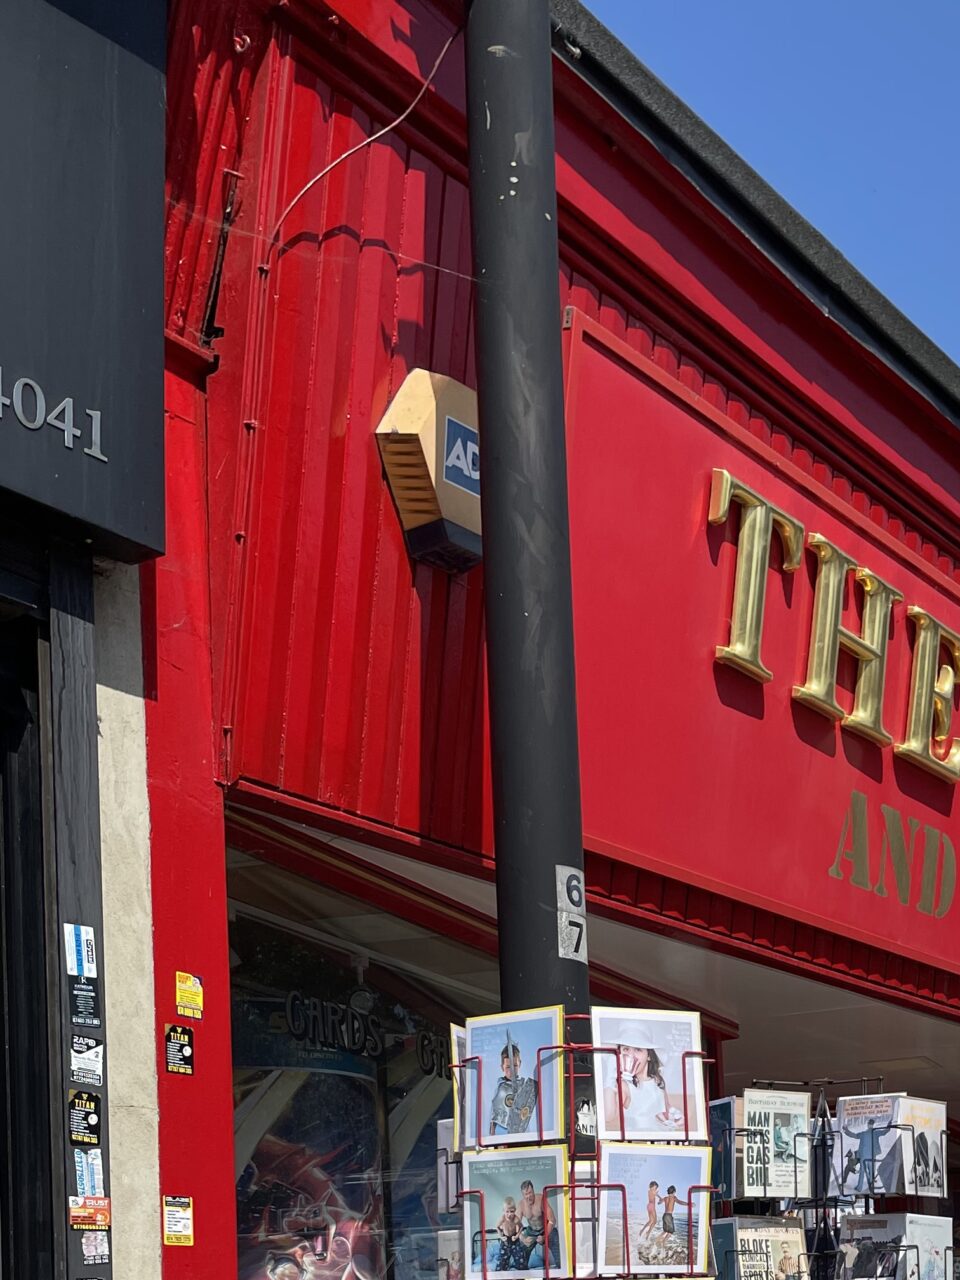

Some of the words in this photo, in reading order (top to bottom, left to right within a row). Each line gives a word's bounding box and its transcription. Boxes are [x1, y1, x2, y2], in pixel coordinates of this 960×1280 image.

[0, 378, 109, 464] 041
[828, 790, 958, 919] AND
[566, 875, 583, 907] 6
[567, 921, 584, 954] 7
[286, 990, 383, 1057] CARDS
[73, 1035, 97, 1047] RAPID
[170, 1032, 189, 1043] TITAN
[75, 1099, 95, 1110] TITAN
[747, 1111, 771, 1128] MAN
[746, 1128, 770, 1145] GETS
[746, 1145, 771, 1165] GAS
[746, 1165, 773, 1188] BILL
[739, 1239, 771, 1254] BLOKE
